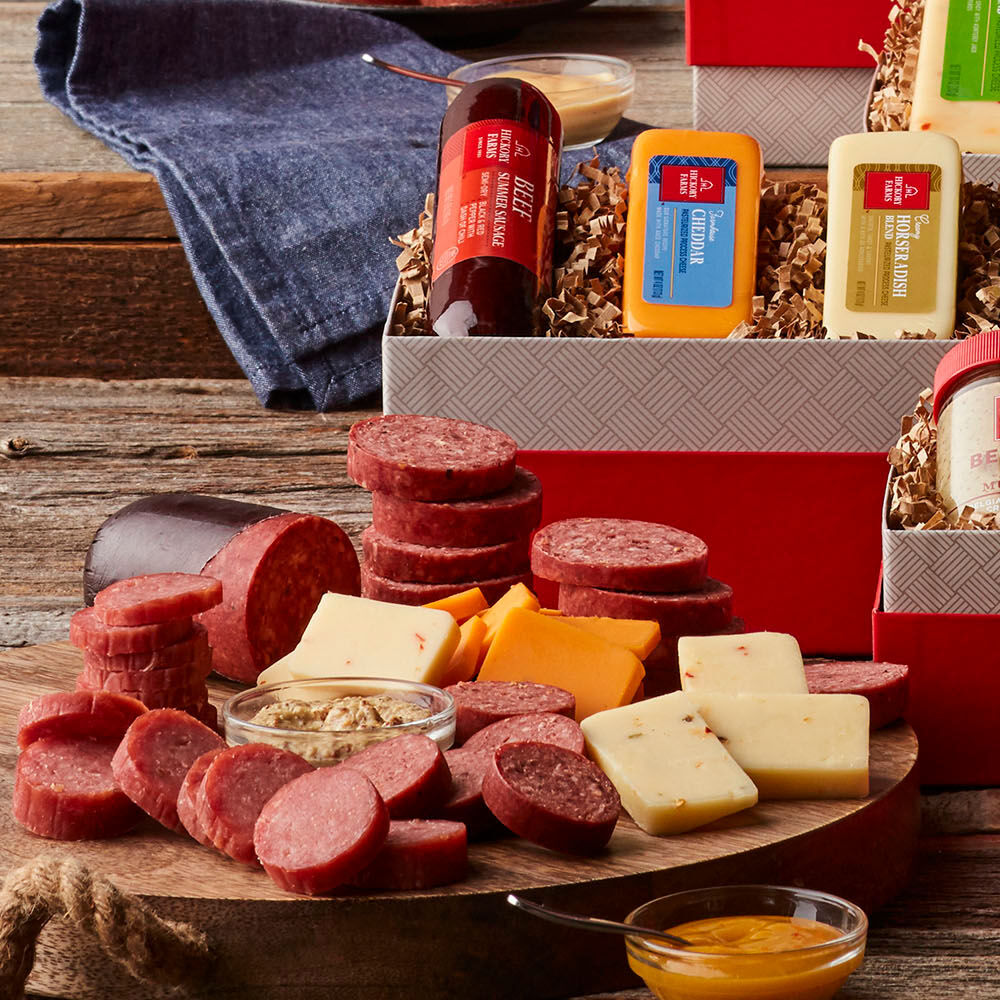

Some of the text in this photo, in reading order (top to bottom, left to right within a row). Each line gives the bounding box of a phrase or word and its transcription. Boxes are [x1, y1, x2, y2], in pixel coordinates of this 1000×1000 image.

[990, 73, 1000, 92] CHEESE
[485, 133, 499, 159] FARMS
[498, 129, 512, 164] HICKORY
[479, 172, 490, 197] SEMI-DRY
[679, 173, 689, 195] FARMS
[688, 170, 699, 199] HICKORY
[884, 180, 893, 202] FARMS
[893, 176, 903, 206] HICKORY
[478, 201, 488, 219] BLACK
[492, 172, 510, 248] SUMMER SAUSAGE
[511, 176, 535, 223] BEEF
[466, 202, 478, 238] PEPPER WITH
[476, 224, 485, 235] RED
[708, 210, 724, 243] Farmhouse
[884, 215, 894, 240] BLEND
[910, 214, 929, 240] Creamy
[457, 229, 466, 244] CHILI
[678, 209, 689, 273] PASTEURIZED PROCESS CHEESE
[689, 208, 706, 265] CHEDDAR
[892, 215, 911, 297] HORSERADISH
[881, 290, 889, 306] CHEESE
